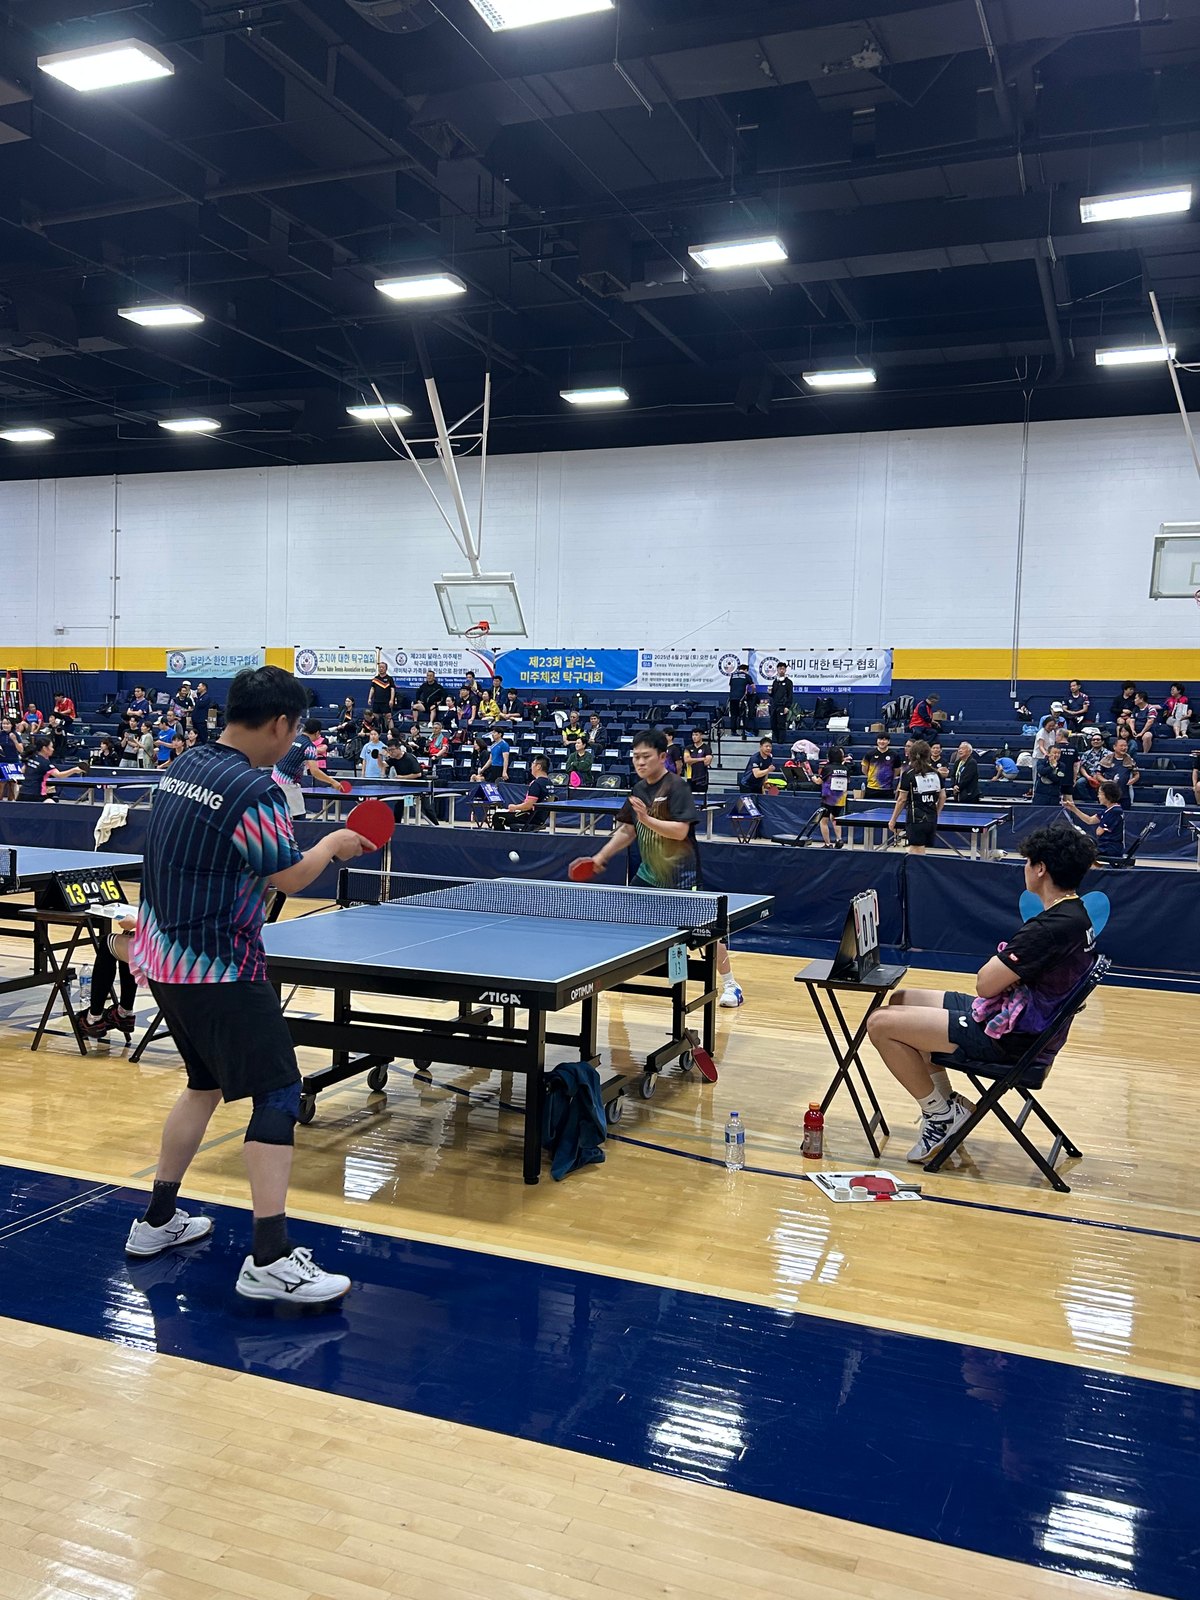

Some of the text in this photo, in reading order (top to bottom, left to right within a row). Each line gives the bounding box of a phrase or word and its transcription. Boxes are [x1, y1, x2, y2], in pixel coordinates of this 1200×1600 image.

[190, 655, 212, 666] 달라스
[229, 654, 259, 666] 탁구협회
[318, 653, 375, 664] 조지아 대한 탁구협회
[528, 655, 597, 669] 제23회 달라스
[786, 659, 879, 671] 재미 대한 탁구 협회
[520, 670, 604, 685] 미주체전 탁구대회
[184, 783, 224, 810] KANG
[921, 794, 934, 803] USA
[66, 883, 86, 904] 13
[100, 880, 120, 900] 15
[478, 991, 521, 1005] STIGA
[570, 982, 594, 1001] OPTIMUM
